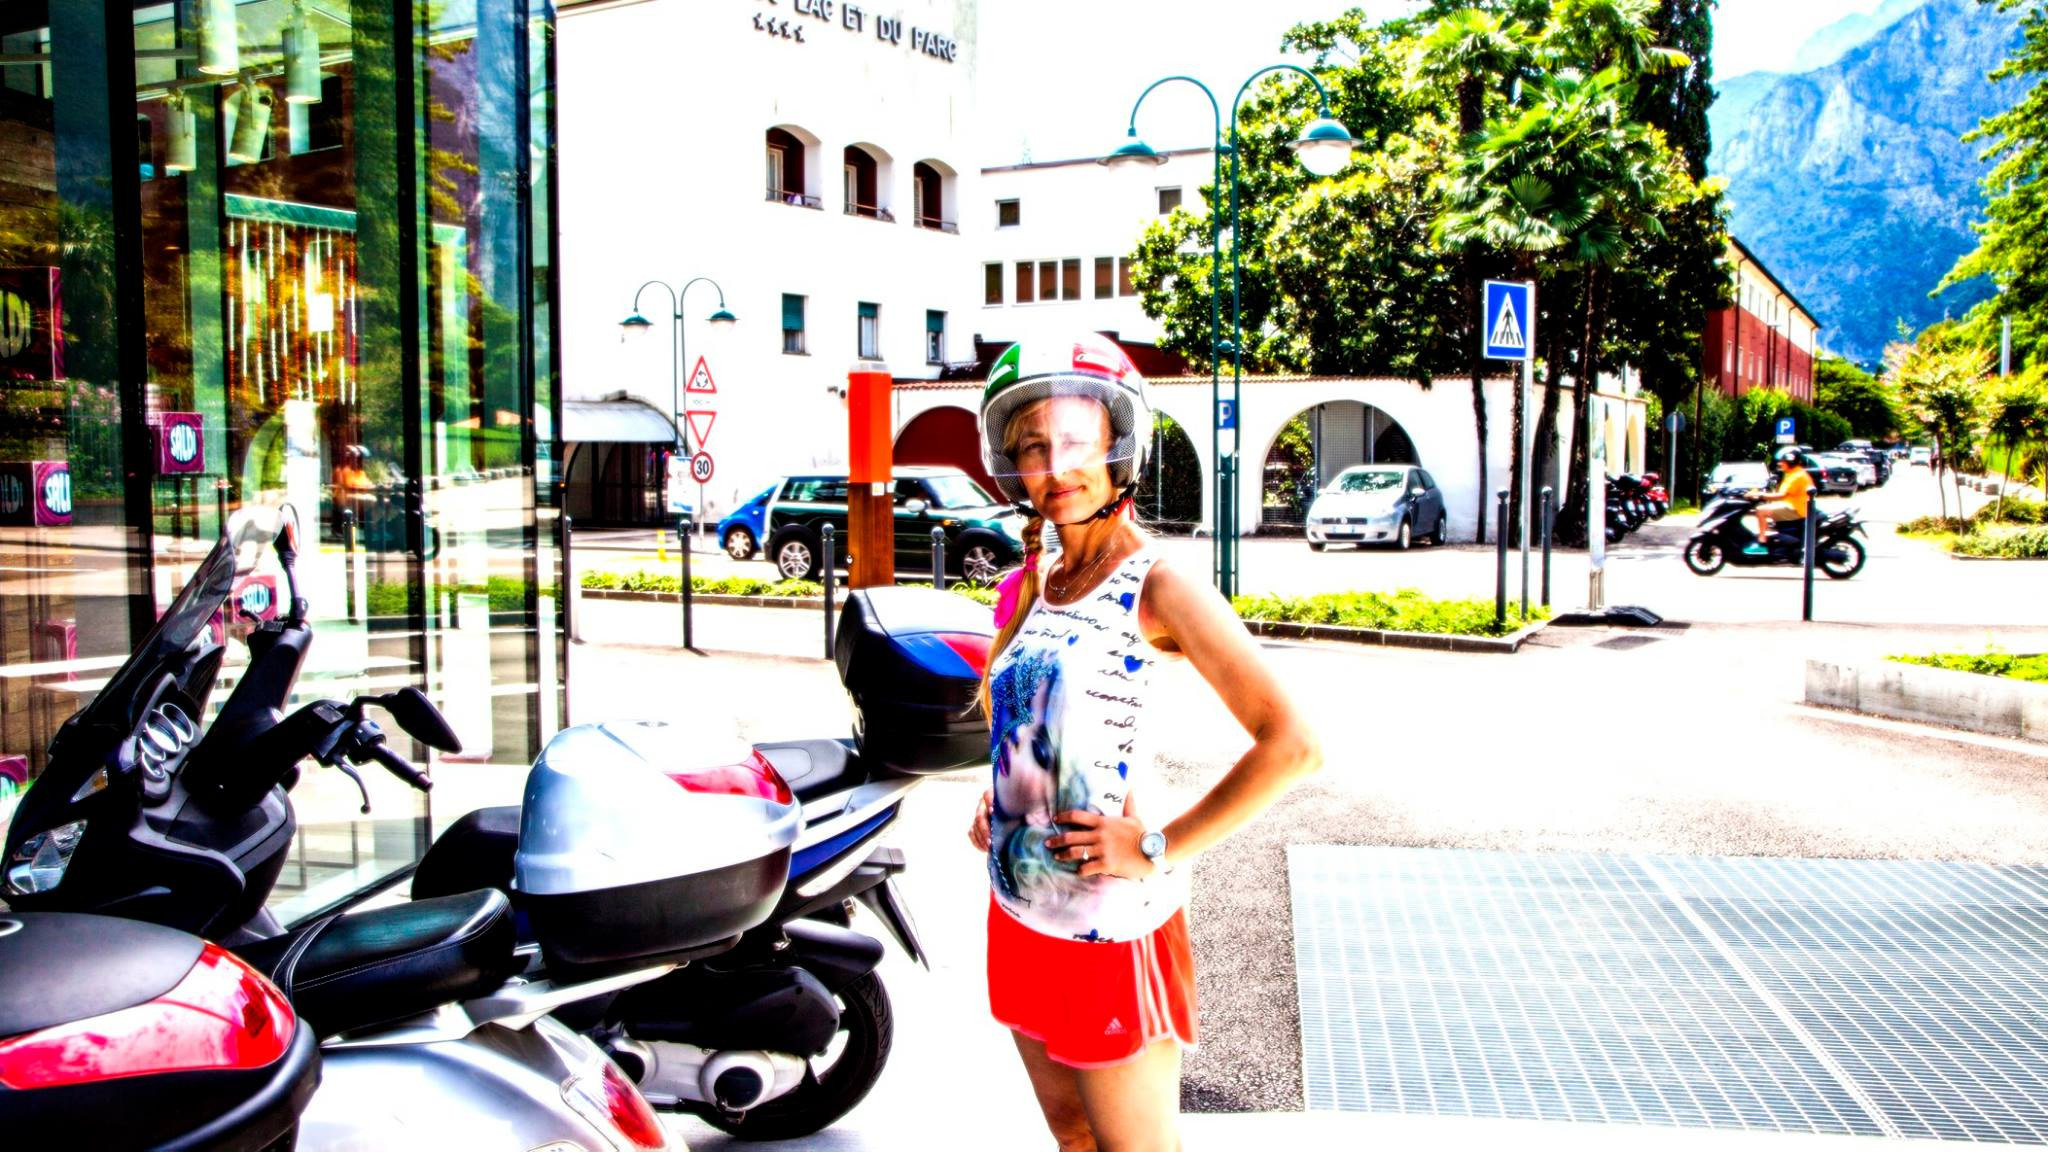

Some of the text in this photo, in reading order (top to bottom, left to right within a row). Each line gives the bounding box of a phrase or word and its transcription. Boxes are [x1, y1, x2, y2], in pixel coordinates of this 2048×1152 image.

[794, 0, 957, 62] LAC ET DU PARC
[1219, 402, 1232, 426] P
[1780, 420, 1791, 434] P
[170, 424, 197, 462] SALDI
[696, 460, 709, 475] 30
[241, 582, 270, 613] SALDI
